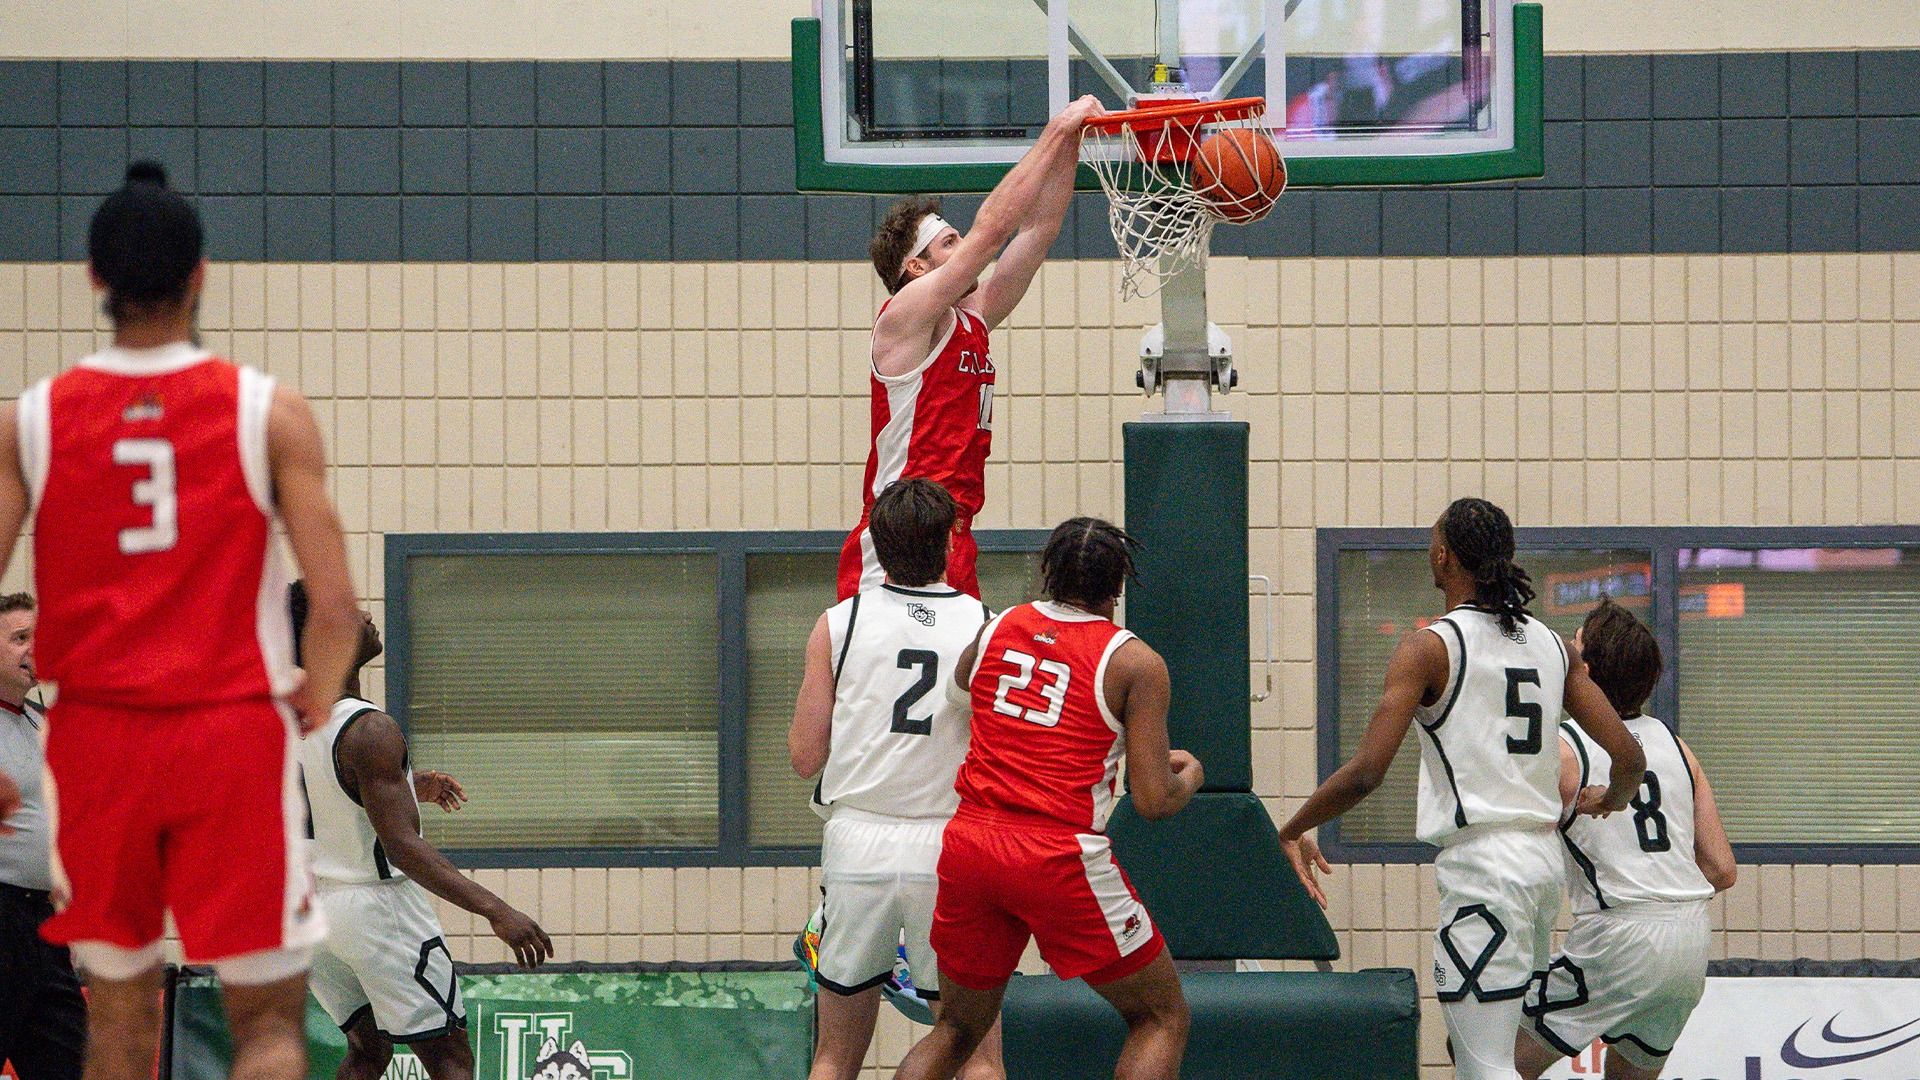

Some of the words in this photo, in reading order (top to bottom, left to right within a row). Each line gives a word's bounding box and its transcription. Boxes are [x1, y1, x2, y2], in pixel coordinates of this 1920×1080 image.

[112, 438, 178, 553] 3
[890, 649, 938, 736] 2
[993, 647, 1071, 727] 23
[1504, 667, 1542, 755] 5
[1629, 770, 1672, 853] 8
